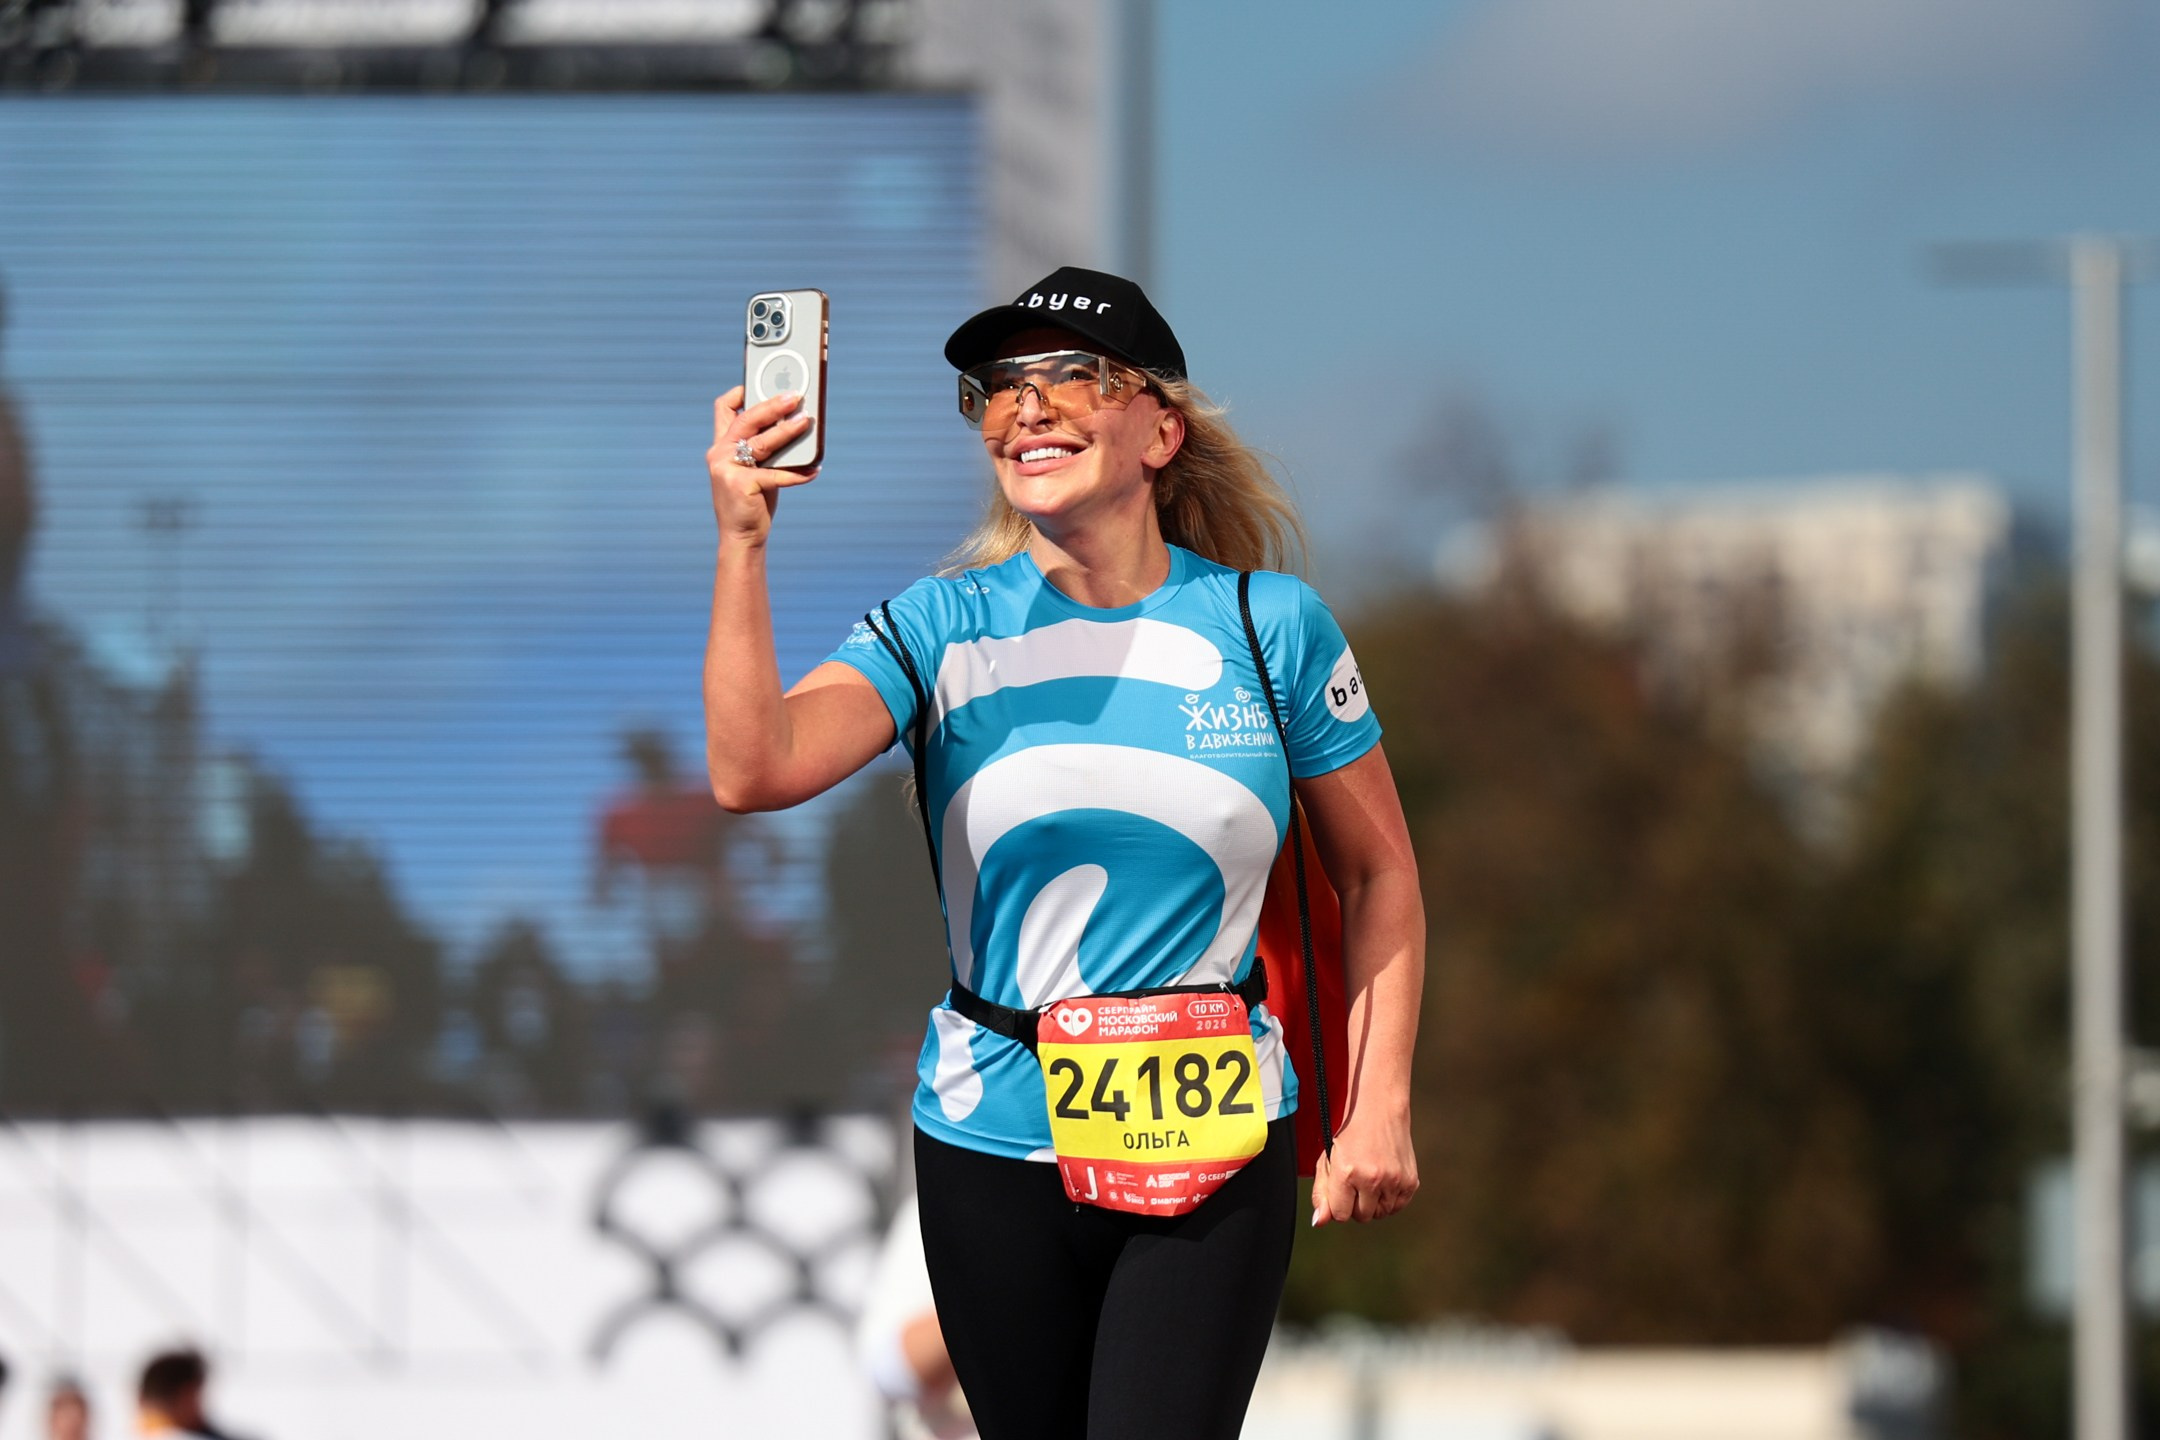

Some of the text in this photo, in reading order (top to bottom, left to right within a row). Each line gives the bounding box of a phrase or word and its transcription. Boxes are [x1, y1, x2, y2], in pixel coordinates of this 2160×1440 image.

[1018, 293, 1111, 314] byer
[1178, 701, 1268, 731] ЖИЗНЬ
[1185, 732, 1275, 750] В ДВИЖЕНИИ
[1098, 1004, 1157, 1015] СБЕРПРАЙМ
[1194, 1003, 1224, 1014] 10 КМ
[1098, 1011, 1178, 1026] МОСКОВСКИЙ
[1099, 1024, 1159, 1036] МАРАФОН
[1049, 1050, 1254, 1122] 24182
[1123, 1130, 1190, 1149] ОЛЬГА
[1085, 1166, 1099, 1200] J
